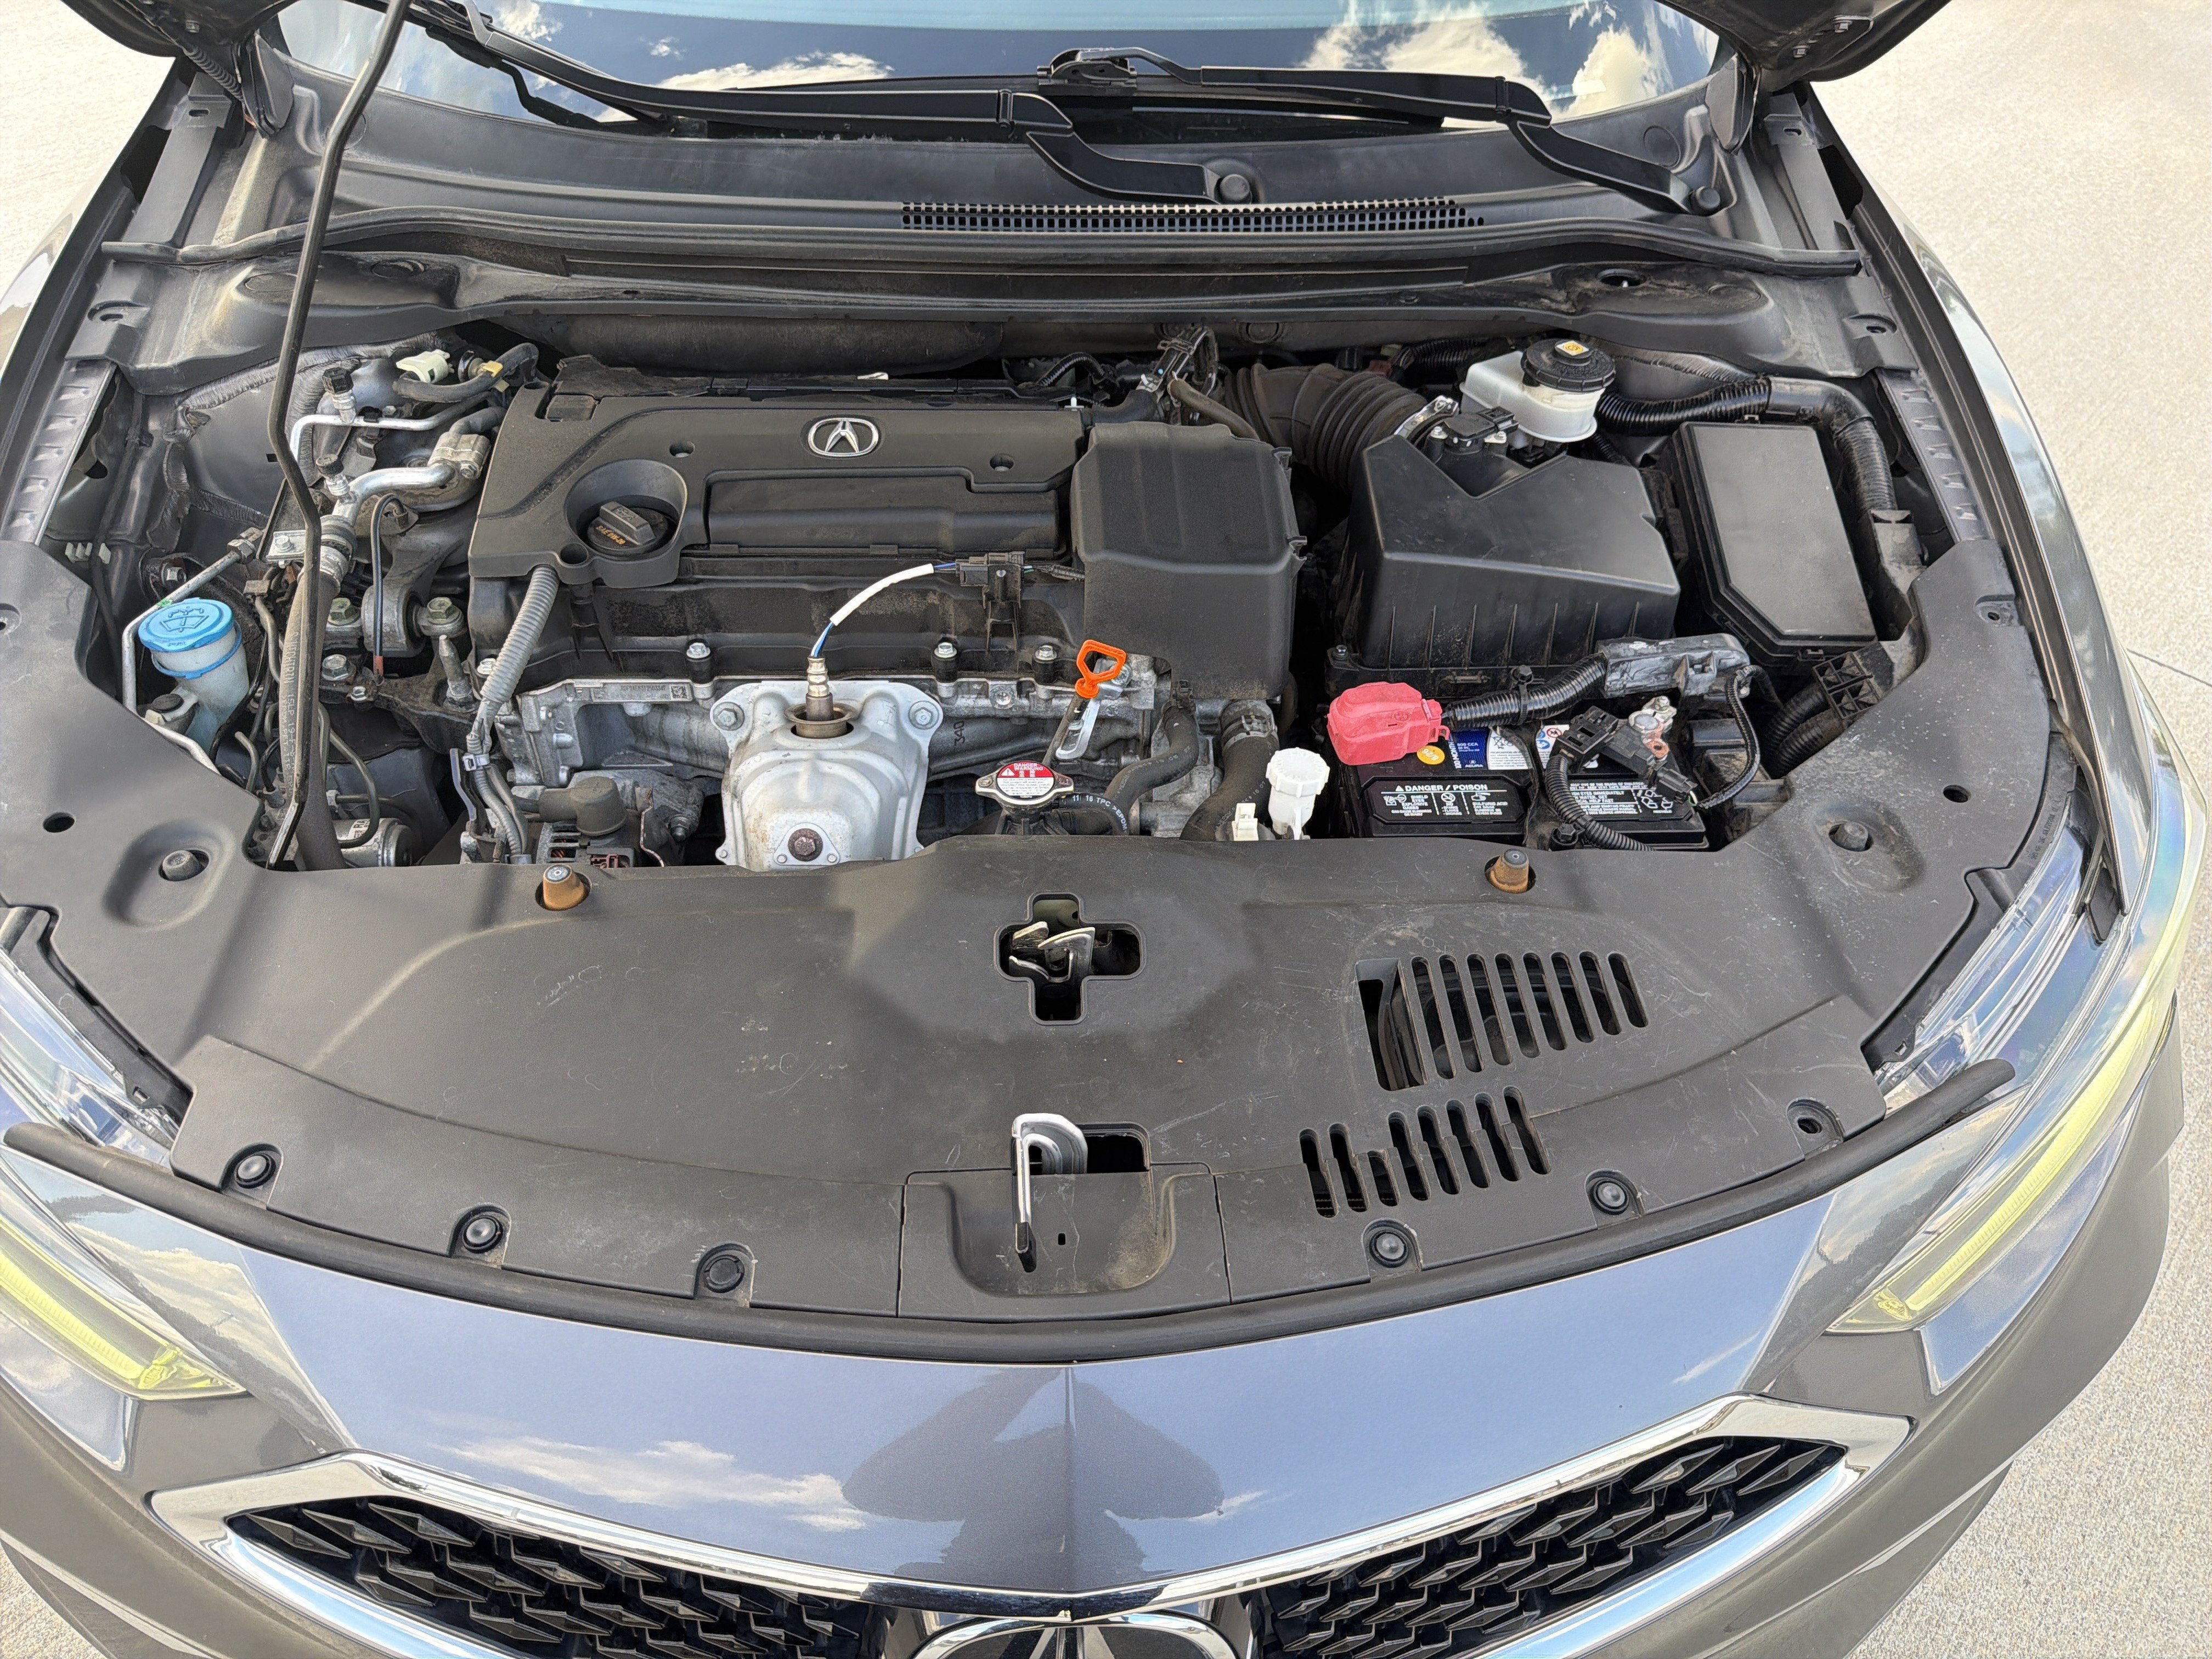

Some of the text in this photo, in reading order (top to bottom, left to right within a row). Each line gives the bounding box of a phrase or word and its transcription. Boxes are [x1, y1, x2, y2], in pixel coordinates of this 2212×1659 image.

[596, 525, 626, 545] SAE 0W-20
[1448, 741, 1462, 769] 100 MONTH
[1096, 797, 1111, 807] TPC
